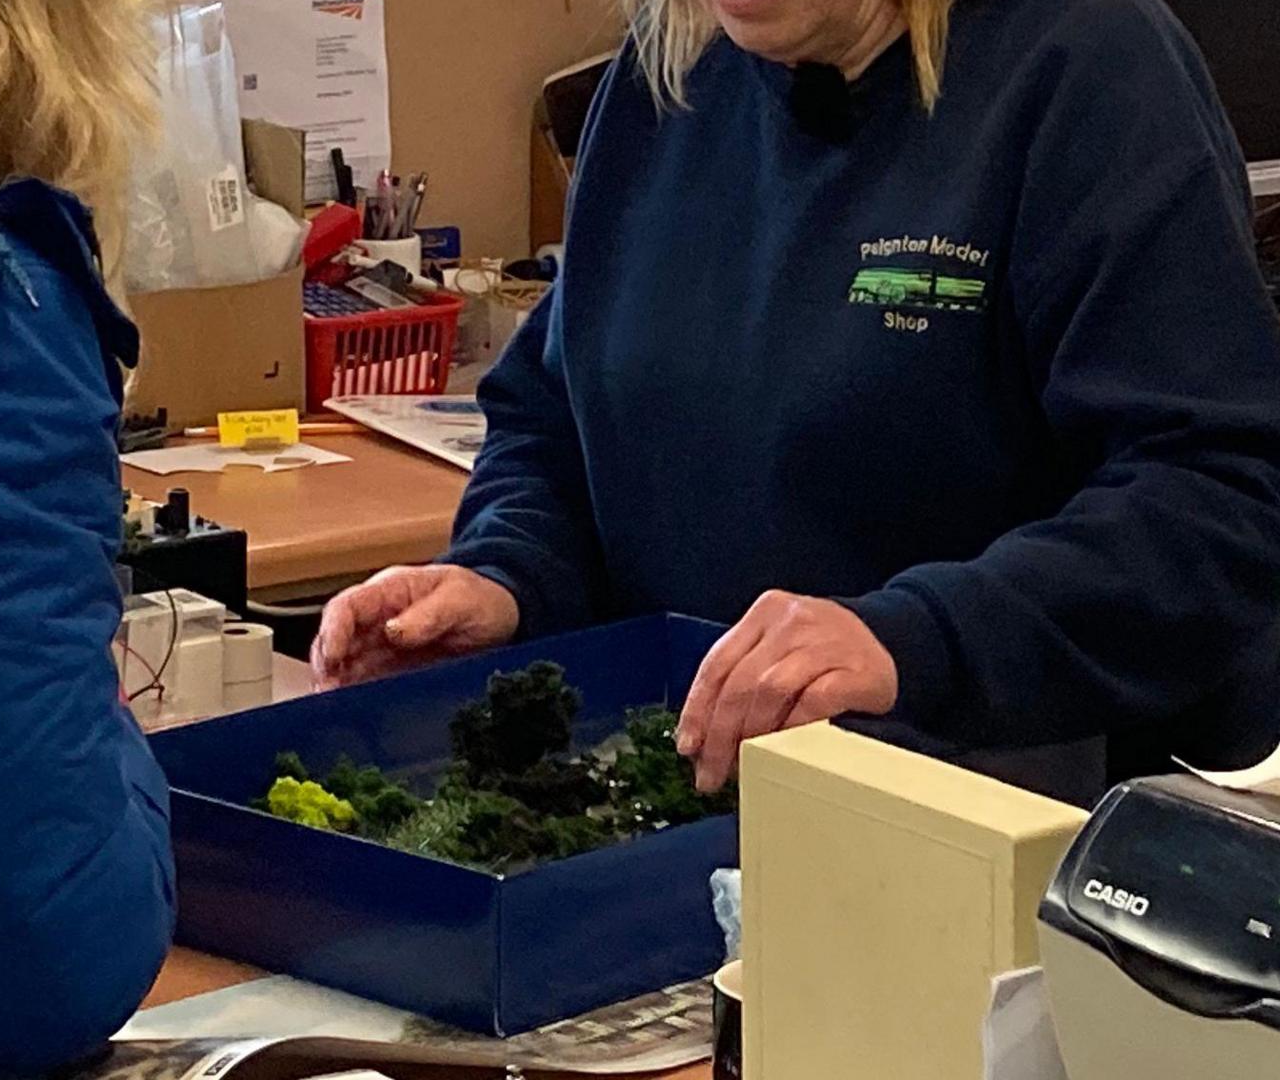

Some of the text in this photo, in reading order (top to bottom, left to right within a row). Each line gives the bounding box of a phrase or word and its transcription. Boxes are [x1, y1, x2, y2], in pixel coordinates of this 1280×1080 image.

[929, 234, 990, 267] Model
[883, 311, 929, 332] Shop
[1083, 879, 1150, 916] CASIO
